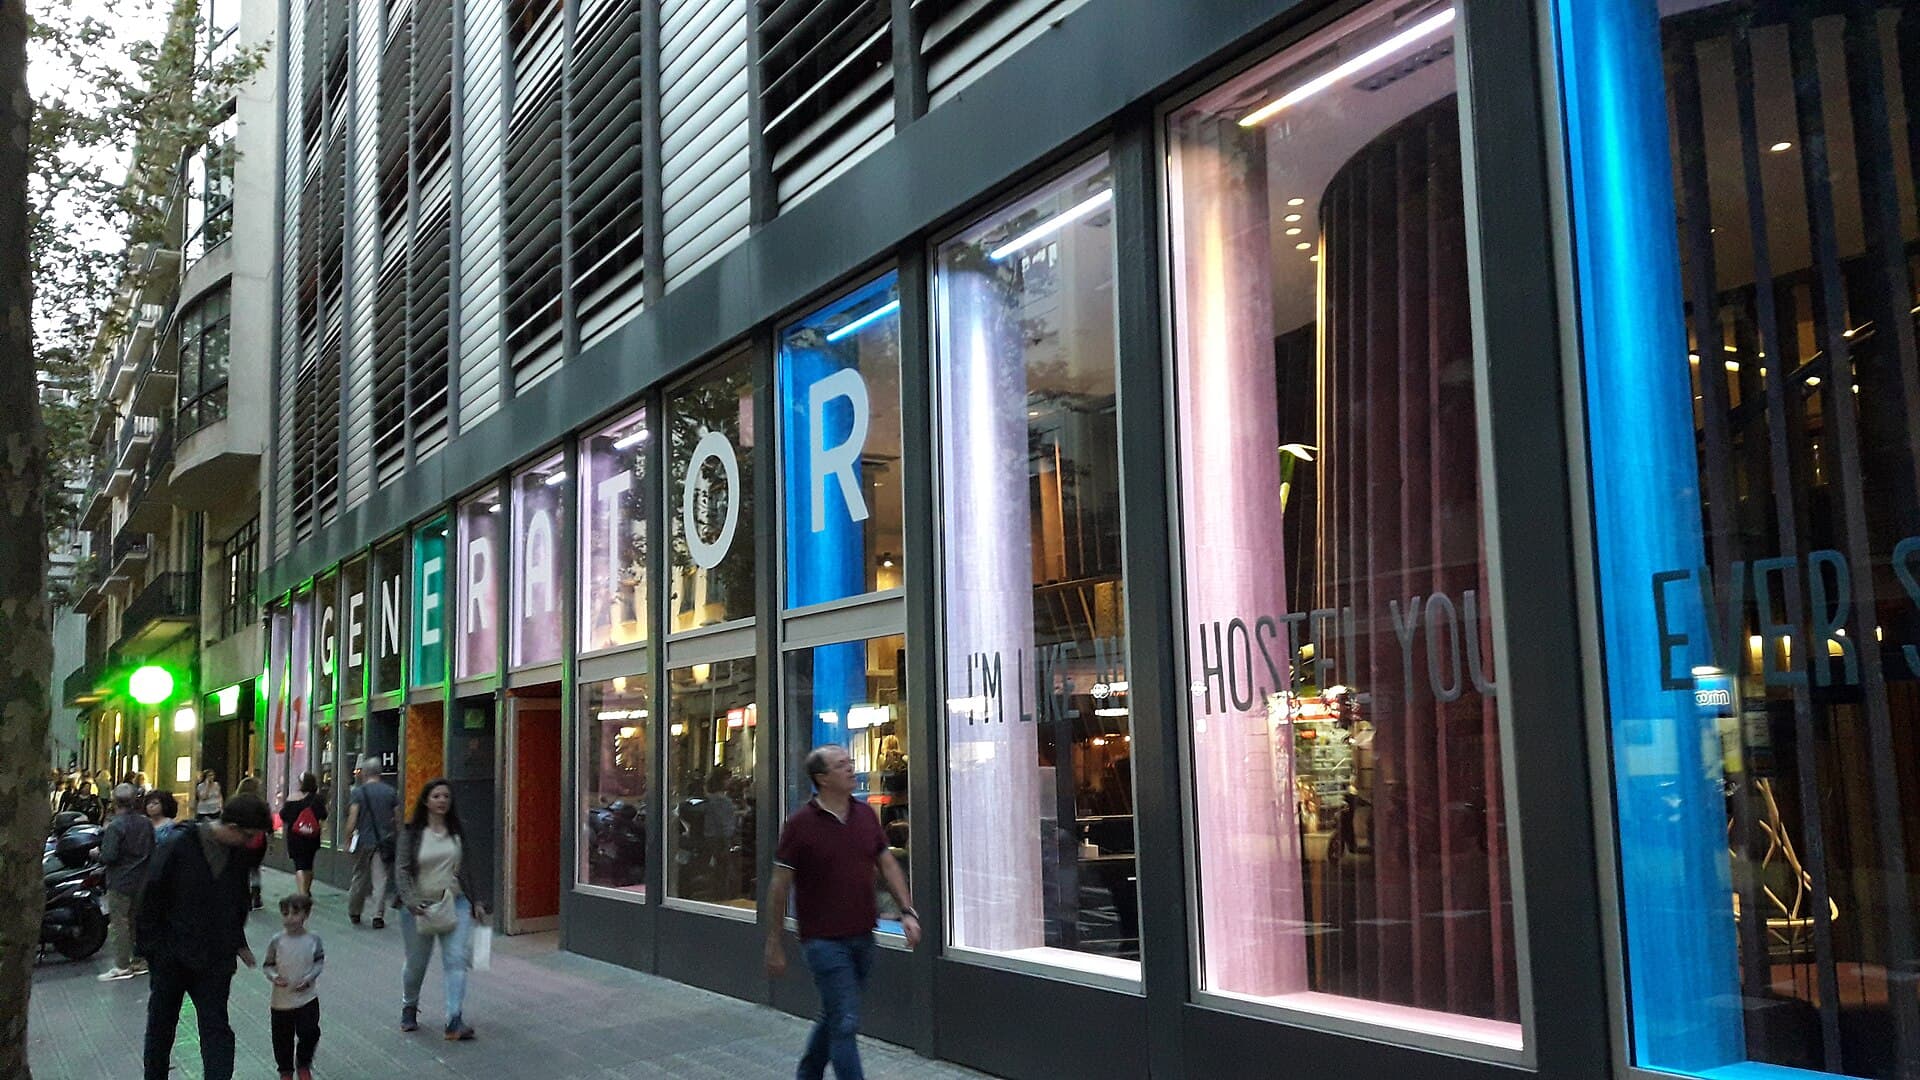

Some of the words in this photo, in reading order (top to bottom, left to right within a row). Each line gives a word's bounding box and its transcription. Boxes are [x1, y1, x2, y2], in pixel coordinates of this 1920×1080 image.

[320, 367, 870, 676] GENERATOR
[967, 652, 1004, 725] I'M
[1018, 641, 1080, 722] LIKE
[1199, 606, 1373, 715] HOSTEL
[1389, 589, 1498, 704] YOU
[1652, 549, 1860, 691] EVER
